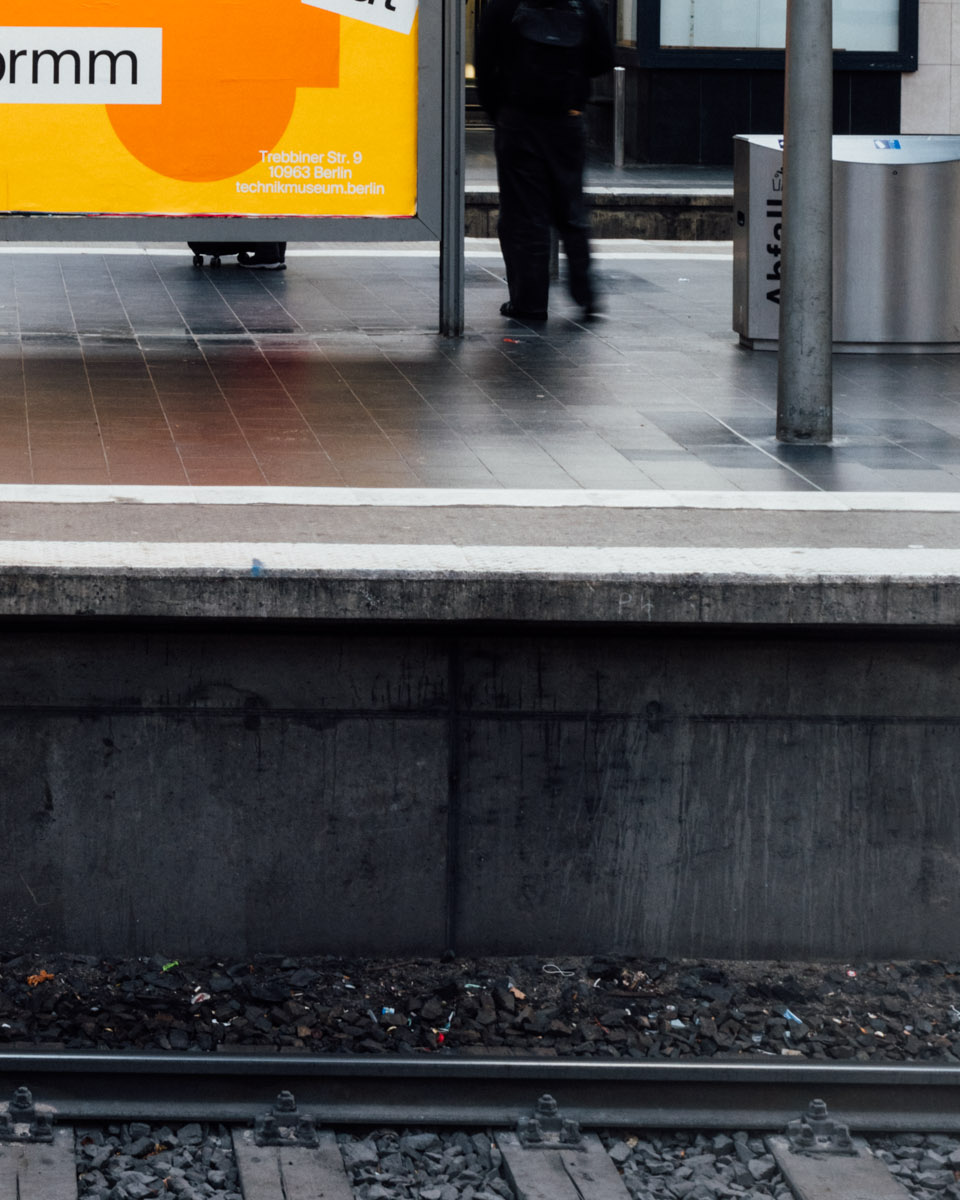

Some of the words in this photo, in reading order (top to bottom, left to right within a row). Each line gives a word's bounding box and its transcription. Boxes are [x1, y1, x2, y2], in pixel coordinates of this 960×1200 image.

[258, 150, 325, 164] Trebbiner
[327, 151, 350, 164] Str.
[352, 151, 363, 164] 9
[268, 165, 311, 179] 10963
[314, 166, 352, 179] Berlin
[235, 181, 385, 195] technikmuseum.berlin
